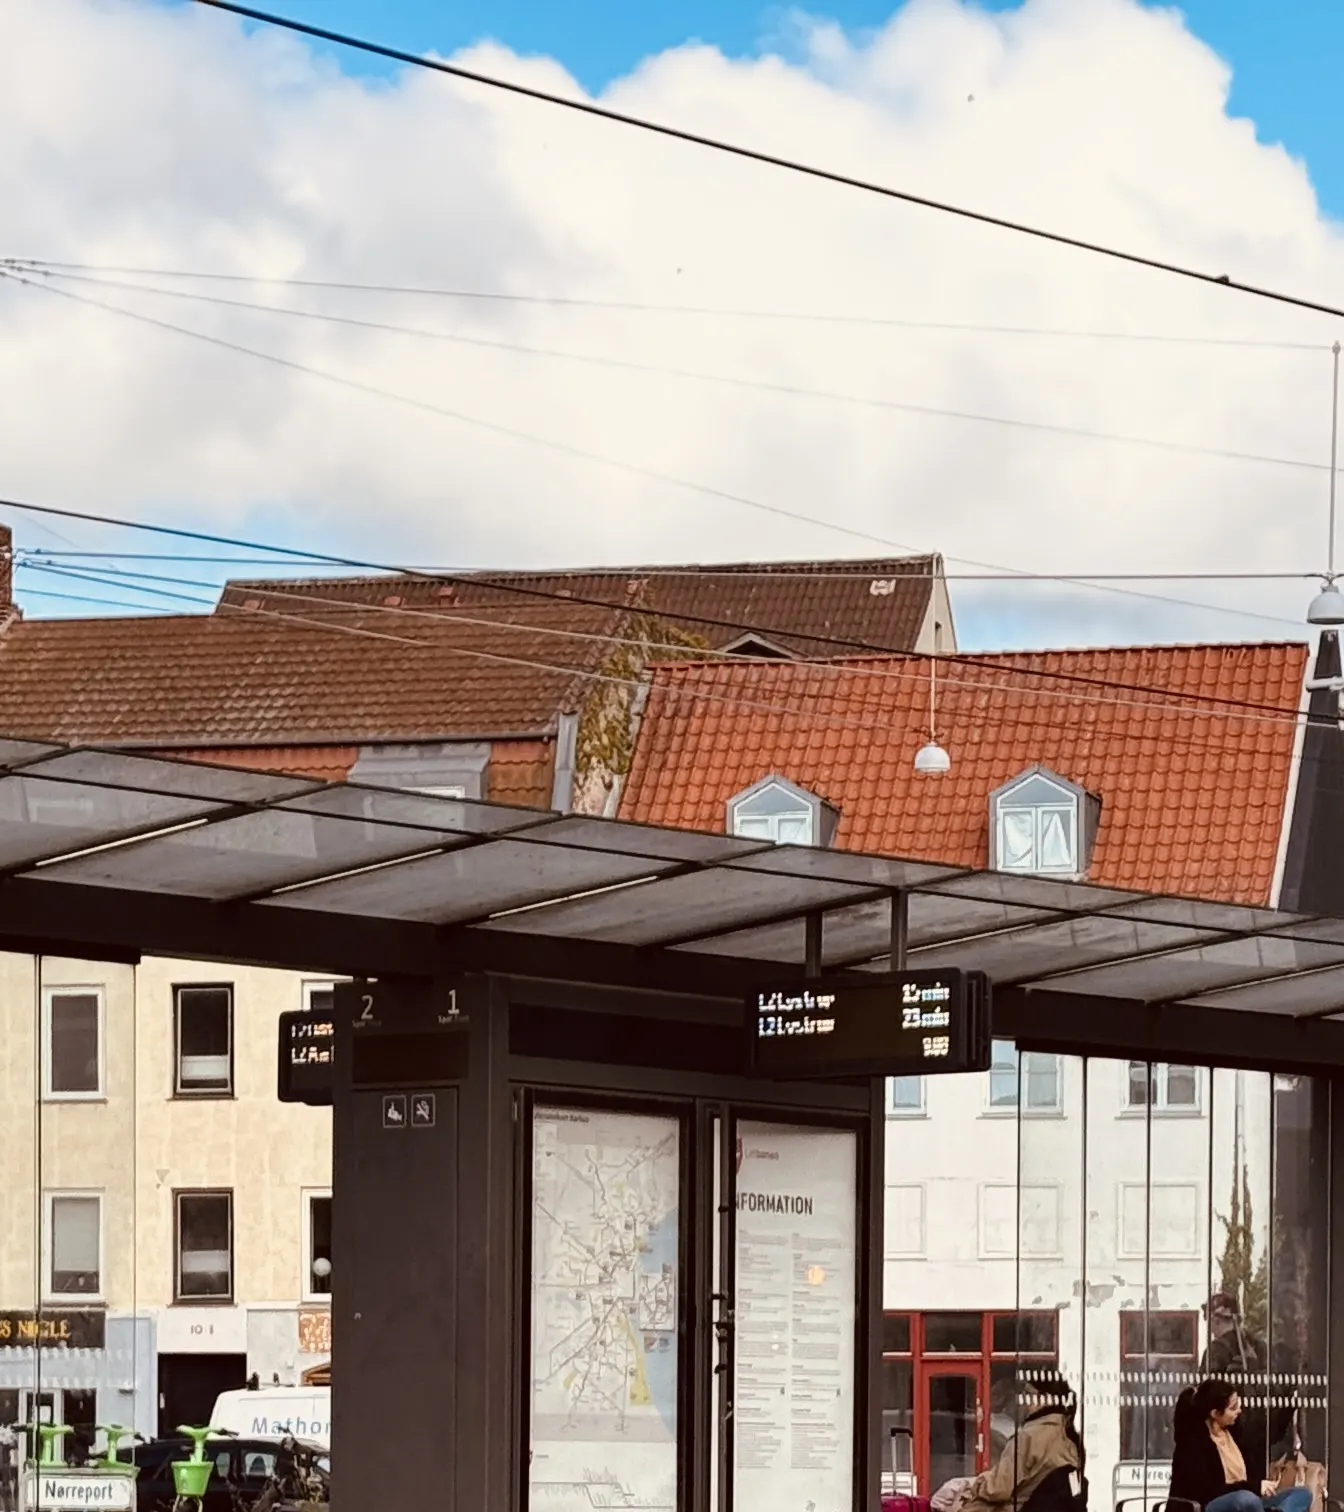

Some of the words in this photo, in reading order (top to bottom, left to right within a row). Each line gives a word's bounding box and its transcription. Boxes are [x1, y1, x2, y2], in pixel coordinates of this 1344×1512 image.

[361, 995, 374, 1019] 2
[448, 989, 460, 1013] 1
[736, 1192, 813, 1215] FORMATION
[45, 1480, 113, 1504] Nørreport
